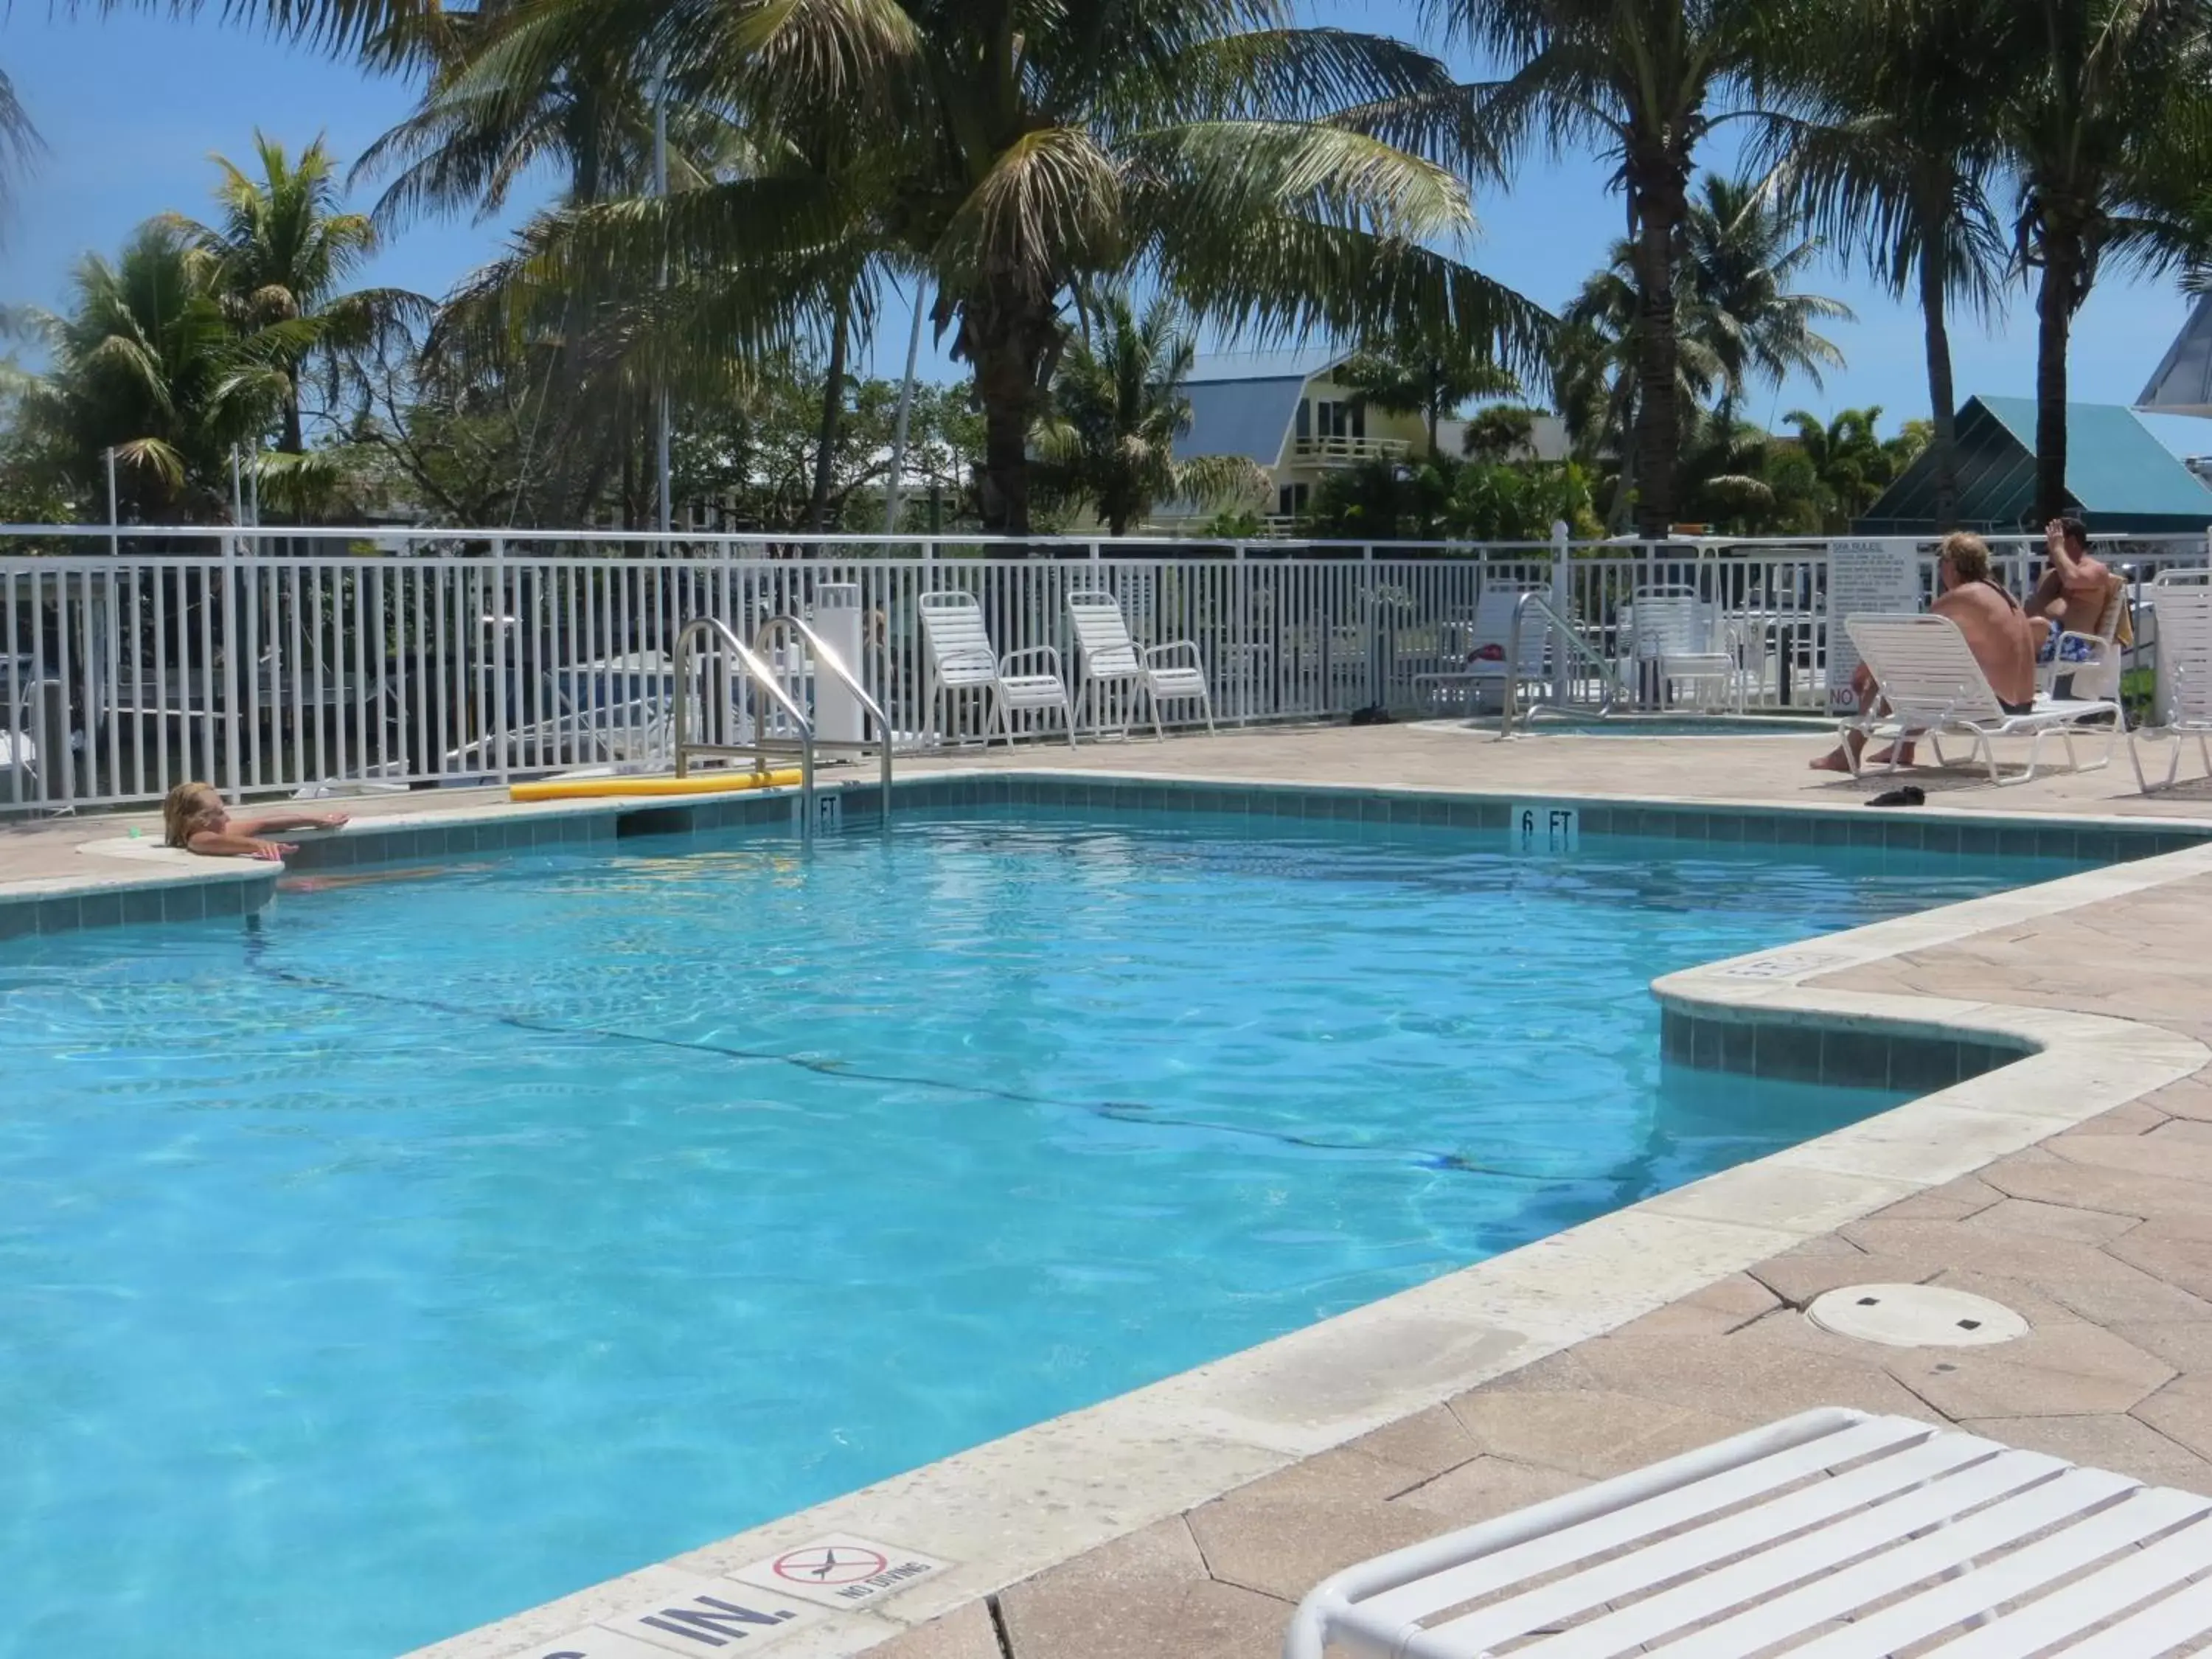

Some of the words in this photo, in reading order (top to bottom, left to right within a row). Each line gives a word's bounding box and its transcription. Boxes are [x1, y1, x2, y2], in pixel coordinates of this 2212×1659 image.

[1829, 688, 1853, 706] NO
[821, 797, 836, 816] FT
[1522, 810, 1534, 832] 6
[1550, 810, 1571, 834] FT
[835, 1585, 874, 1599] NO
[864, 1561, 932, 1587] DIVING
[639, 1595, 797, 1647] IN.
